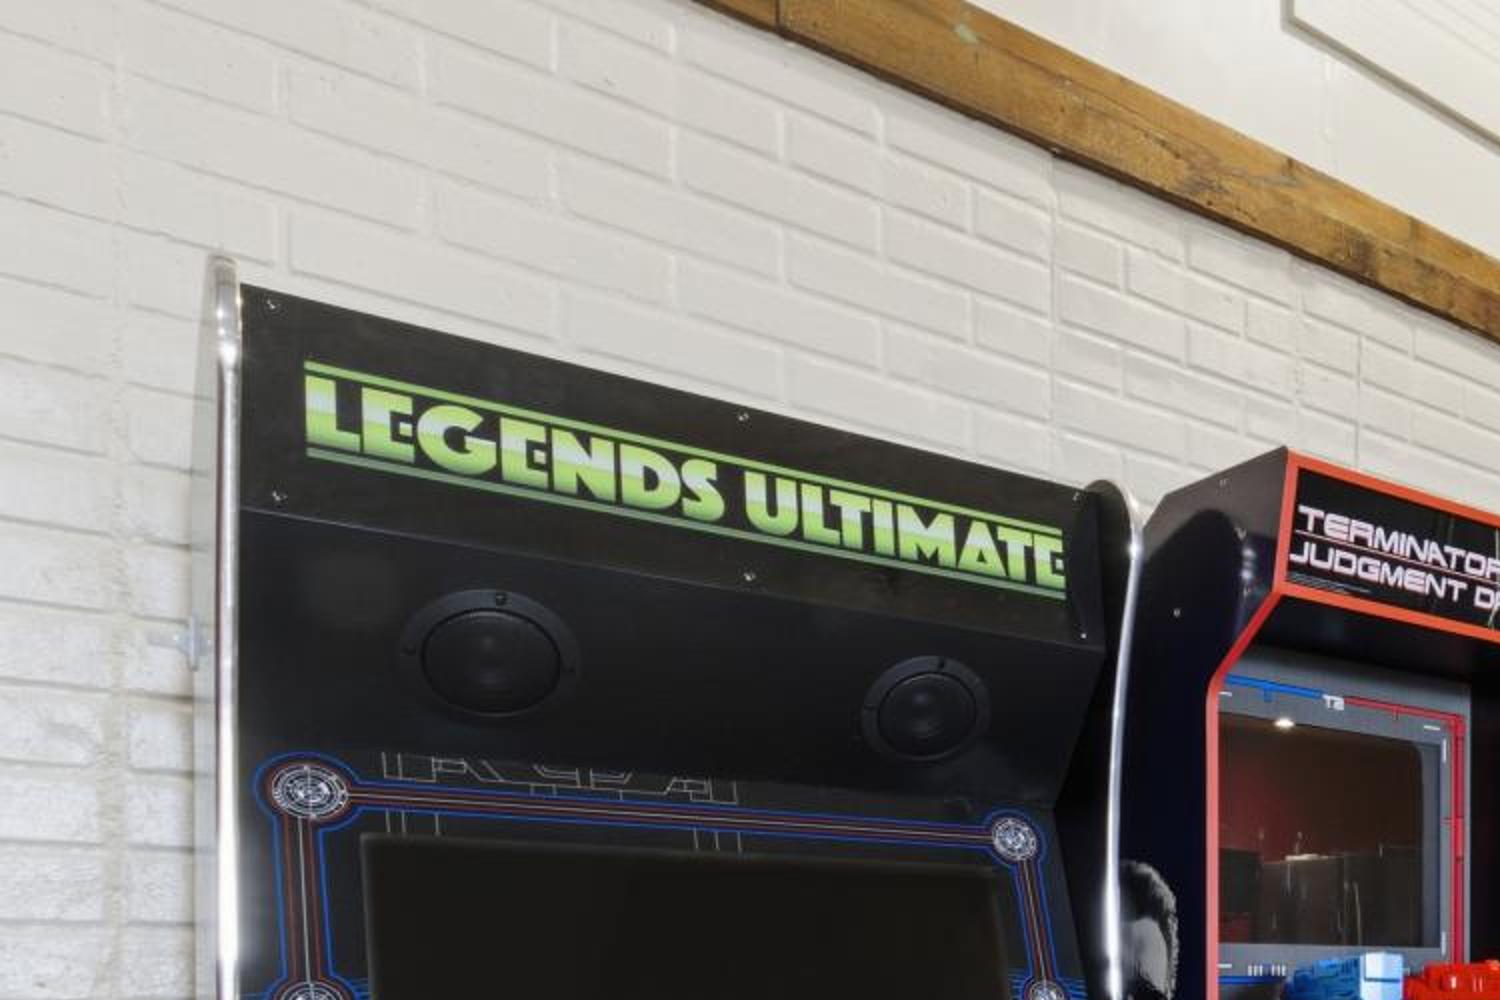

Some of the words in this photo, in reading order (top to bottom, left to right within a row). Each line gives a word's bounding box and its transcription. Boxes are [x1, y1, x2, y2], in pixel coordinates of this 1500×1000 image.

[304, 374, 723, 520] LEGENDS
[743, 472, 1067, 587] ULTIMATE
[1289, 541, 1468, 602] JUDGMENT
